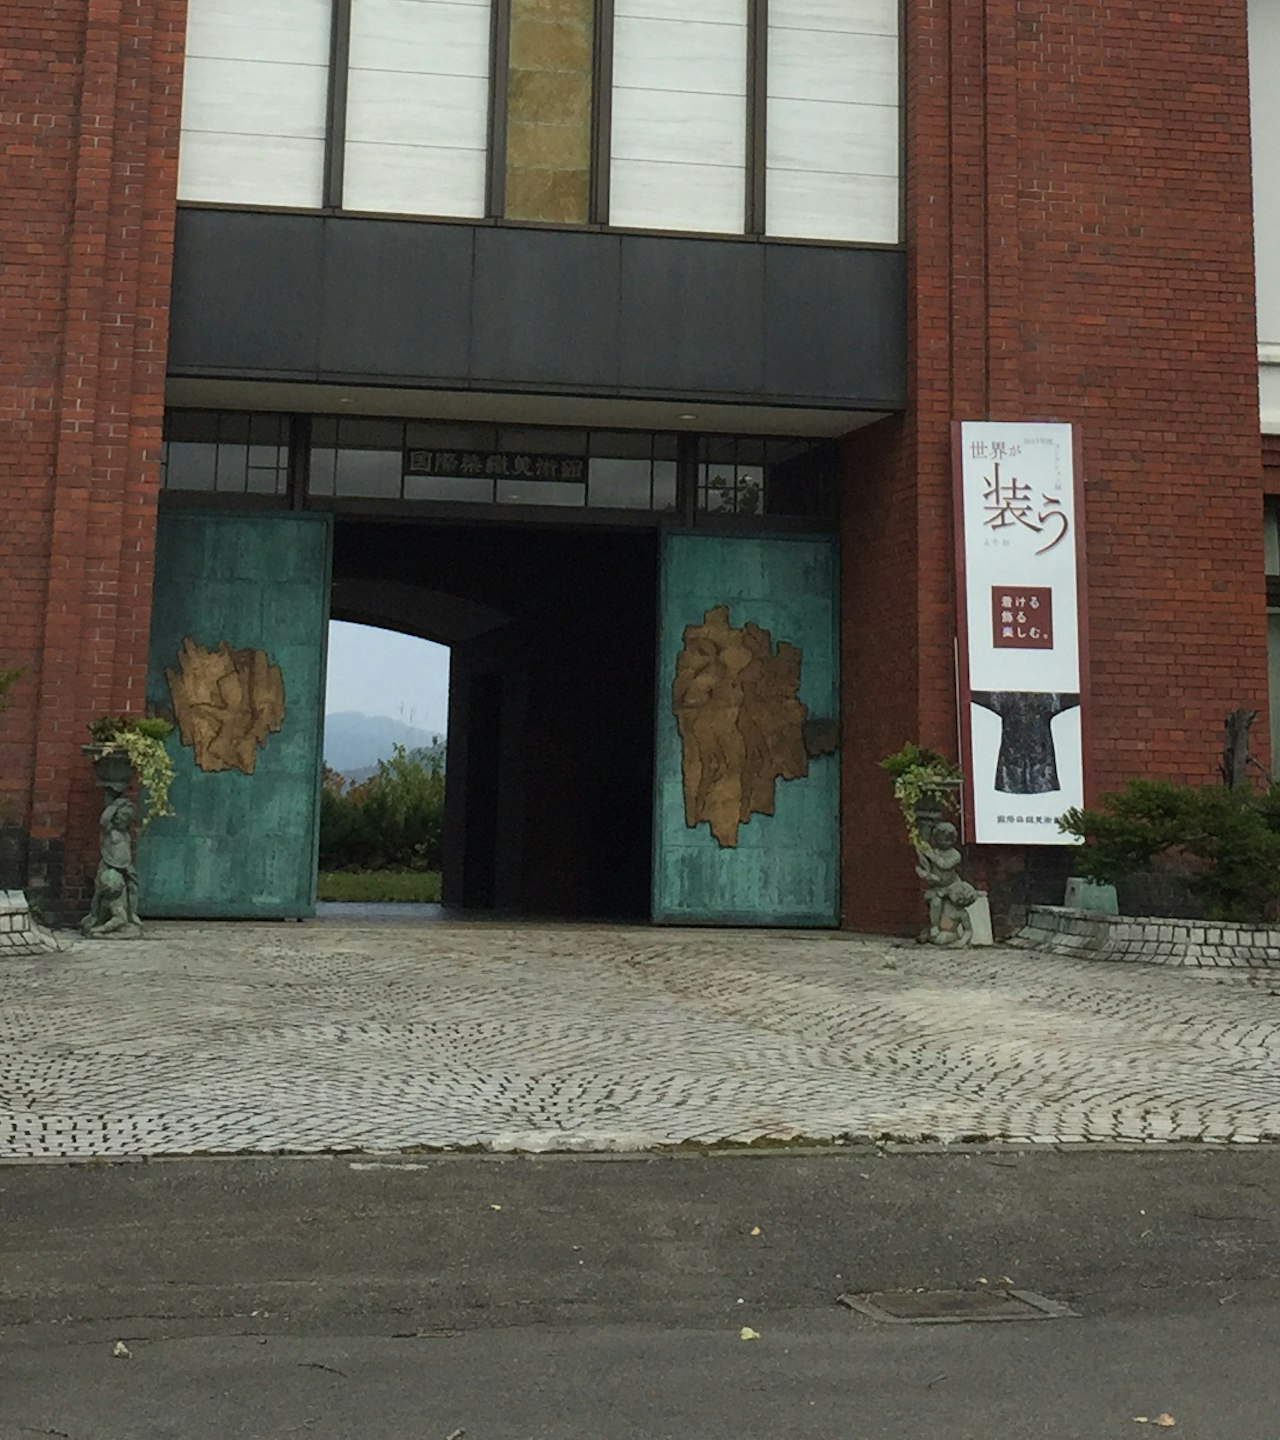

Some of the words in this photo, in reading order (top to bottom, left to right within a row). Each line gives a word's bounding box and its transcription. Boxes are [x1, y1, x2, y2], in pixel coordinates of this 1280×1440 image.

[970, 440, 1022, 460] 世界が
[982, 462, 1070, 556] 装う
